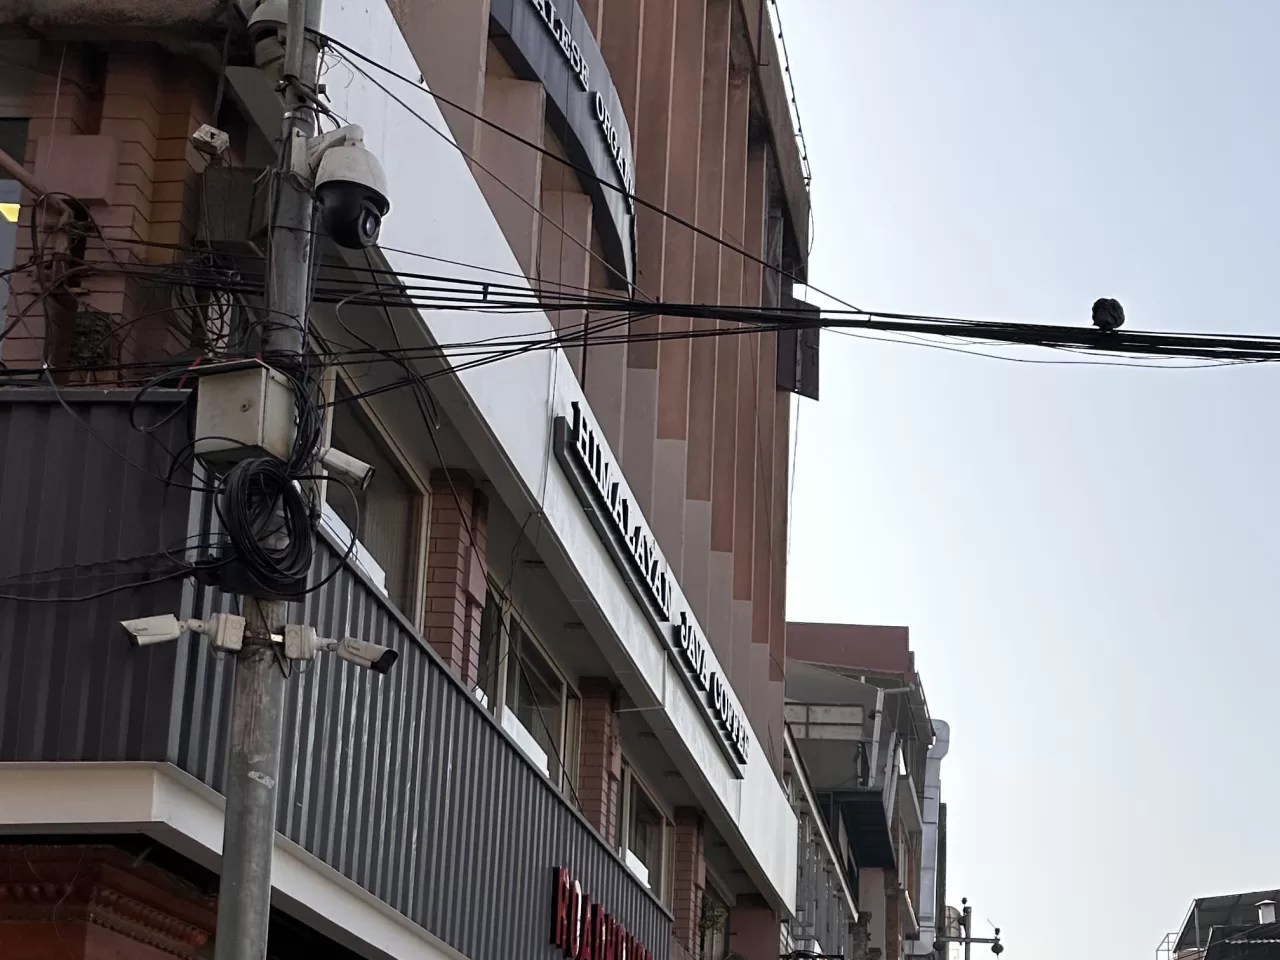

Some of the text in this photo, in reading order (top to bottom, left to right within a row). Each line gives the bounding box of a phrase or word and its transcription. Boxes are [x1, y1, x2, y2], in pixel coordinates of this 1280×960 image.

[571, 401, 749, 764] HIMALAYAN JAVA COFFEE
